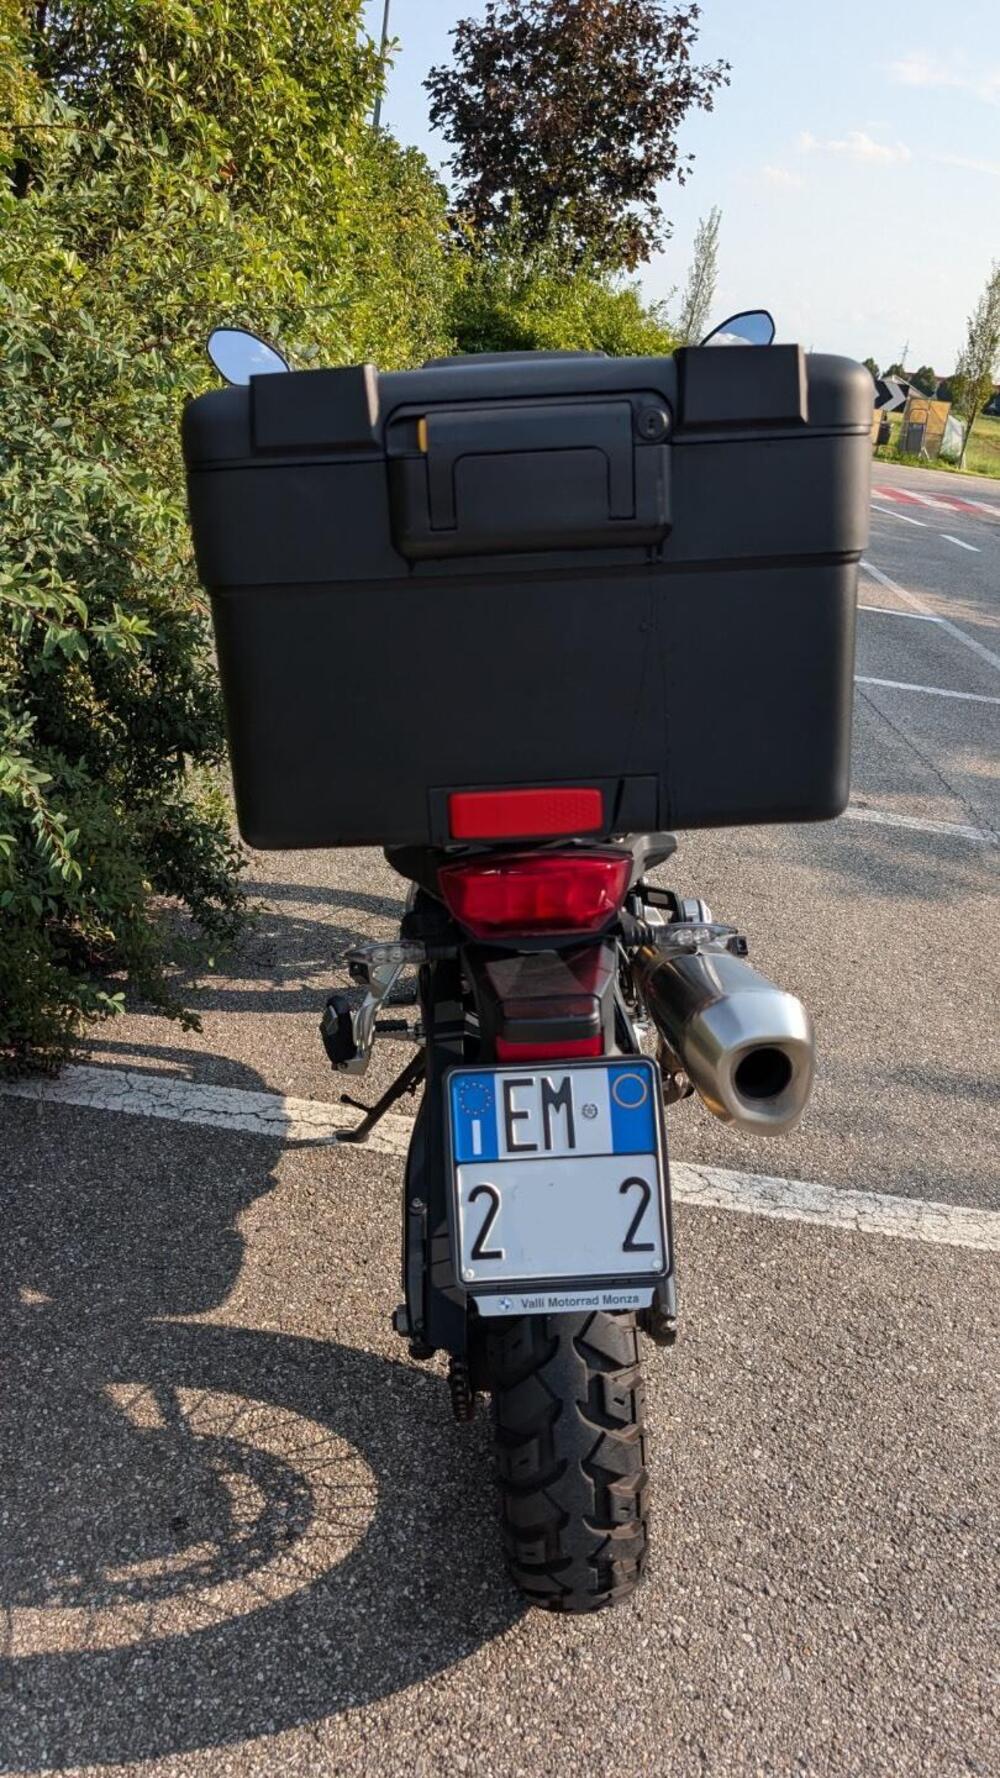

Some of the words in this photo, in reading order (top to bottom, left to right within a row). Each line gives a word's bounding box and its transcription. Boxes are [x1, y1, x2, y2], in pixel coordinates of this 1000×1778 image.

[503, 1076, 576, 1152] EM
[467, 1184, 504, 1260] 2
[619, 1176, 655, 1252] 2
[521, 1298, 545, 1309] Valli
[548, 1295, 599, 1307] Motorrad
[603, 1293, 640, 1305] Monza
